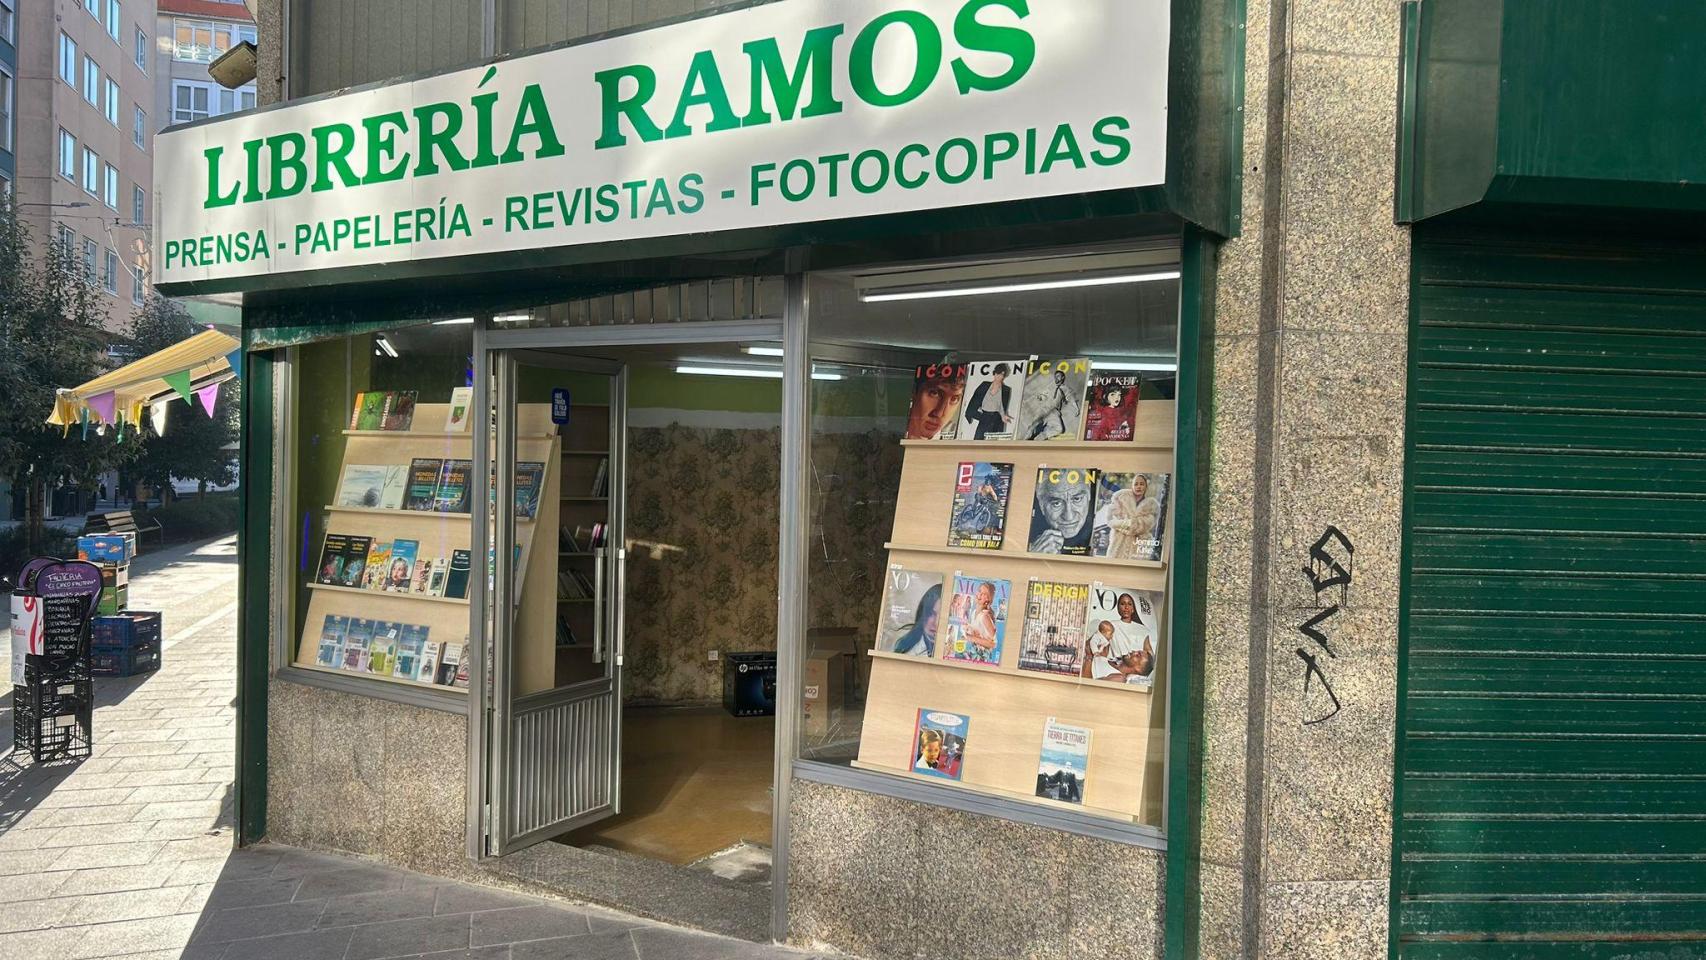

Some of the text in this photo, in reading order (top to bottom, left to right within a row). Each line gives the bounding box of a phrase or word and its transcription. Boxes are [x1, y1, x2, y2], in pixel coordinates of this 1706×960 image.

[203, 0, 1038, 210] LIBRERÍA RAMOS
[165, 229, 270, 270] PRENSA
[293, 196, 472, 256] PAPELERÍA
[504, 173, 705, 233] REVISTAS
[750, 115, 1133, 207] FOTOCOPIAS
[916, 363, 966, 379] ICON
[970, 361, 1024, 376] ICN
[1028, 360, 1087, 375] ICON
[1038, 469, 1096, 484] ICON
[1033, 583, 1089, 600] DESIGN
